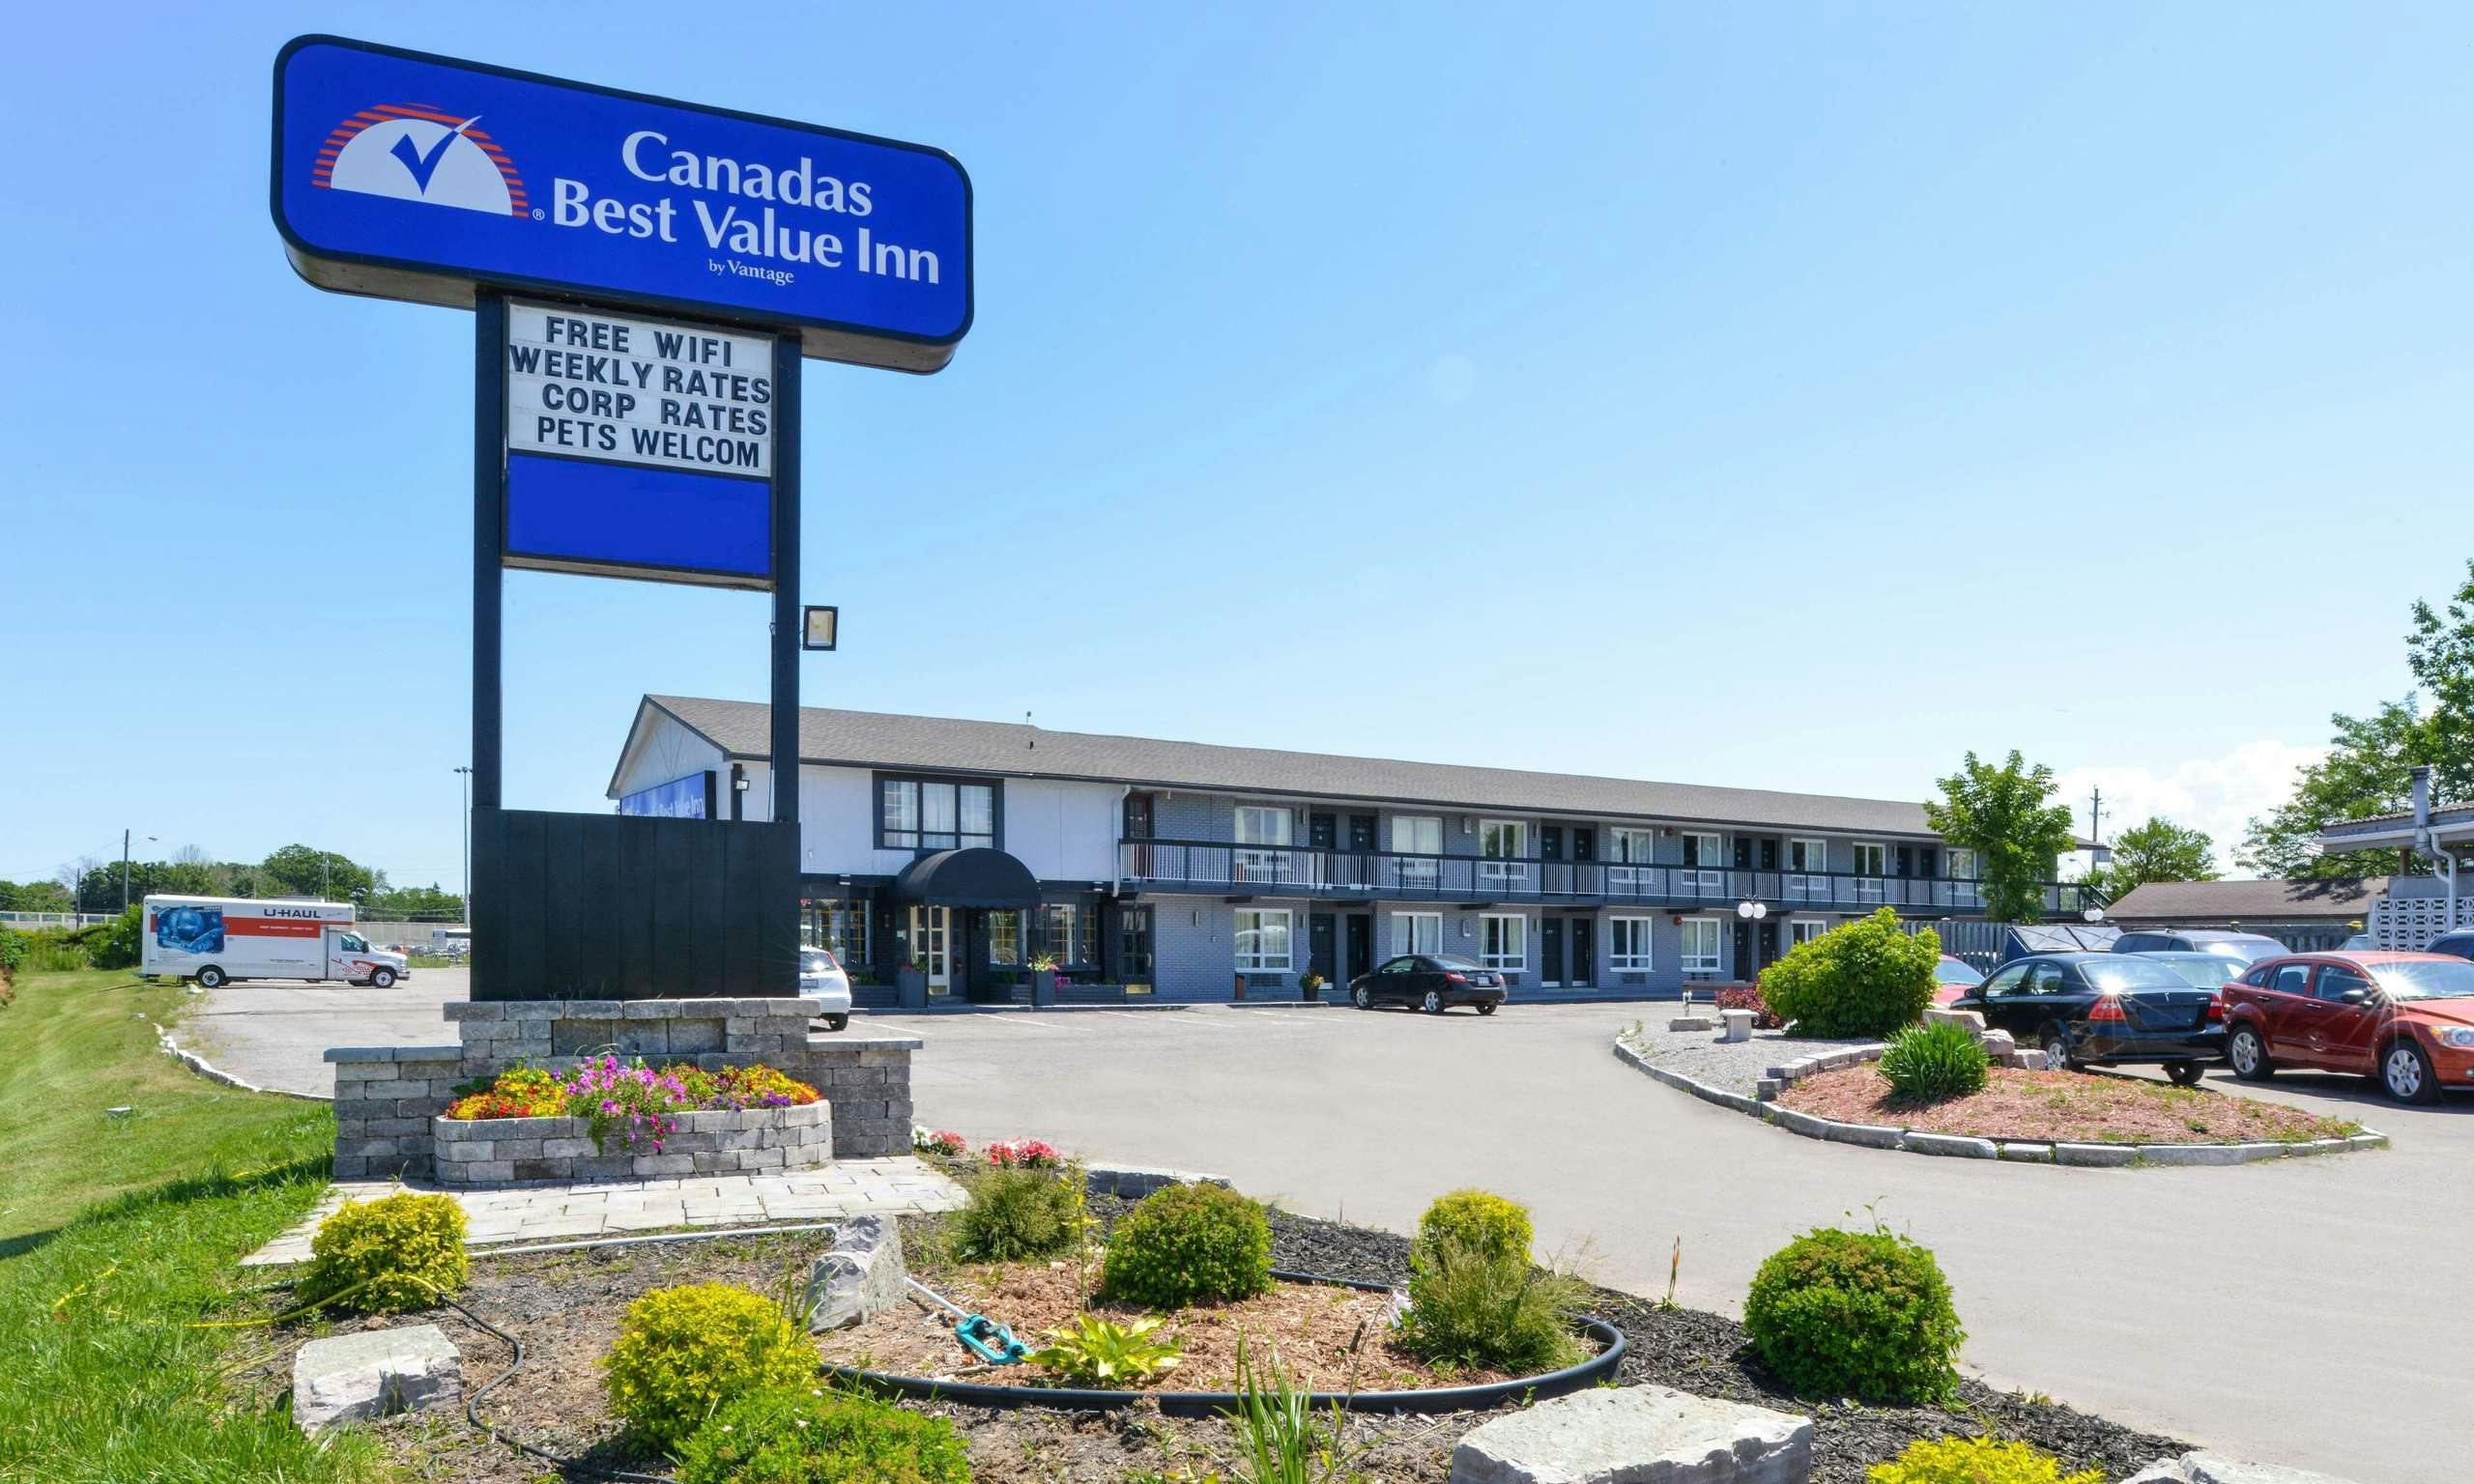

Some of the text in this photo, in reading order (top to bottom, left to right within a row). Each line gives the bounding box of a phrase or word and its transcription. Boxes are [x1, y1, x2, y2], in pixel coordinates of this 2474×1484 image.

[621, 130, 873, 216] Canadas
[554, 178, 677, 243] Best
[693, 200, 843, 268] Value
[858, 227, 939, 284] Inn
[708, 259, 794, 286] by Vantage
[546, 315, 732, 367] FREE WIFI
[509, 344, 771, 404] WEEKLY RATES
[542, 383, 767, 436] CORP RATES
[538, 415, 759, 469] PETS WELCOM
